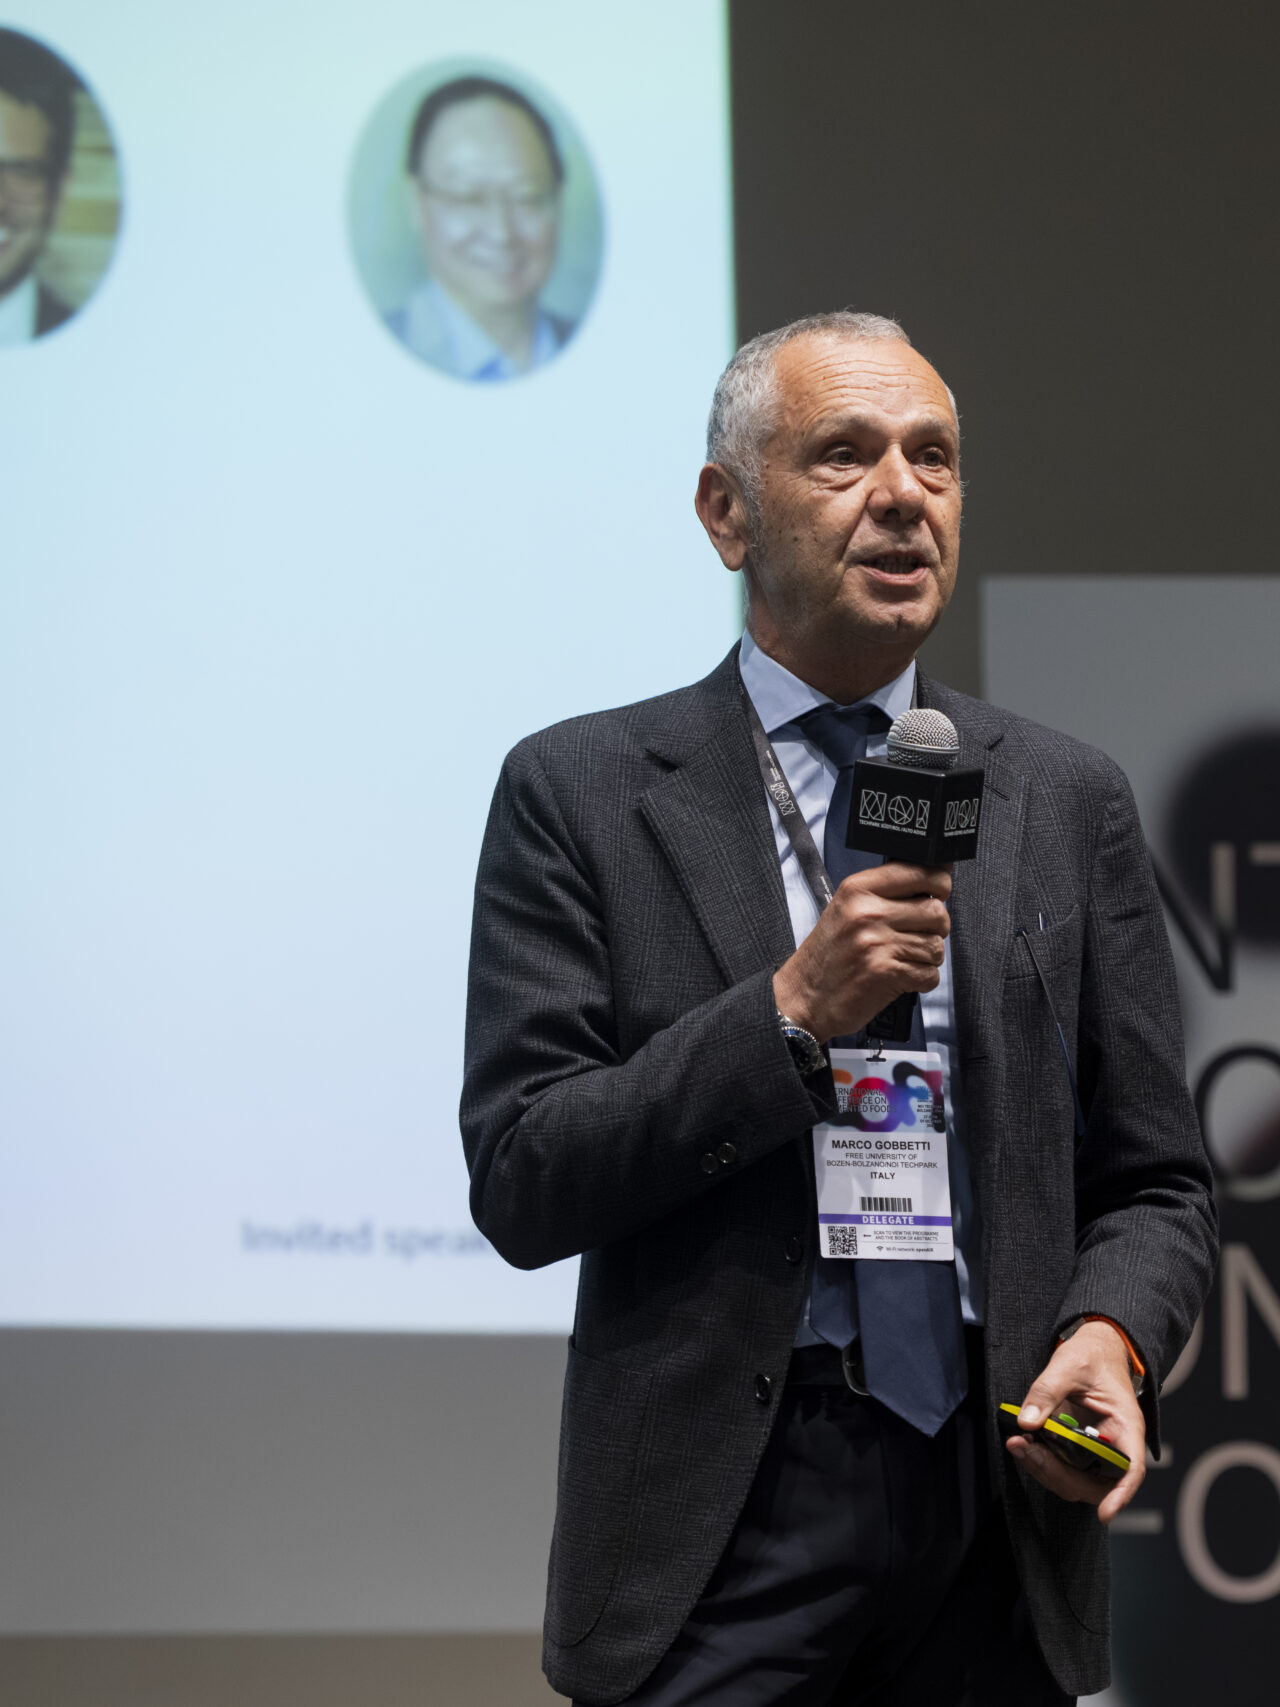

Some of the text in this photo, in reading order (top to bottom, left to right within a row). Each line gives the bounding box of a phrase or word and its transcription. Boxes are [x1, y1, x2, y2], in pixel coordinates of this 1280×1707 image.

[838, 1096, 887, 1104] FERENCE ON
[831, 1140, 931, 1151] MARCO GOBBETTI
[901, 1161, 938, 1169] TECHPARK
[870, 1171, 896, 1180] ITALY
[862, 1215, 915, 1225] DELEGATE
